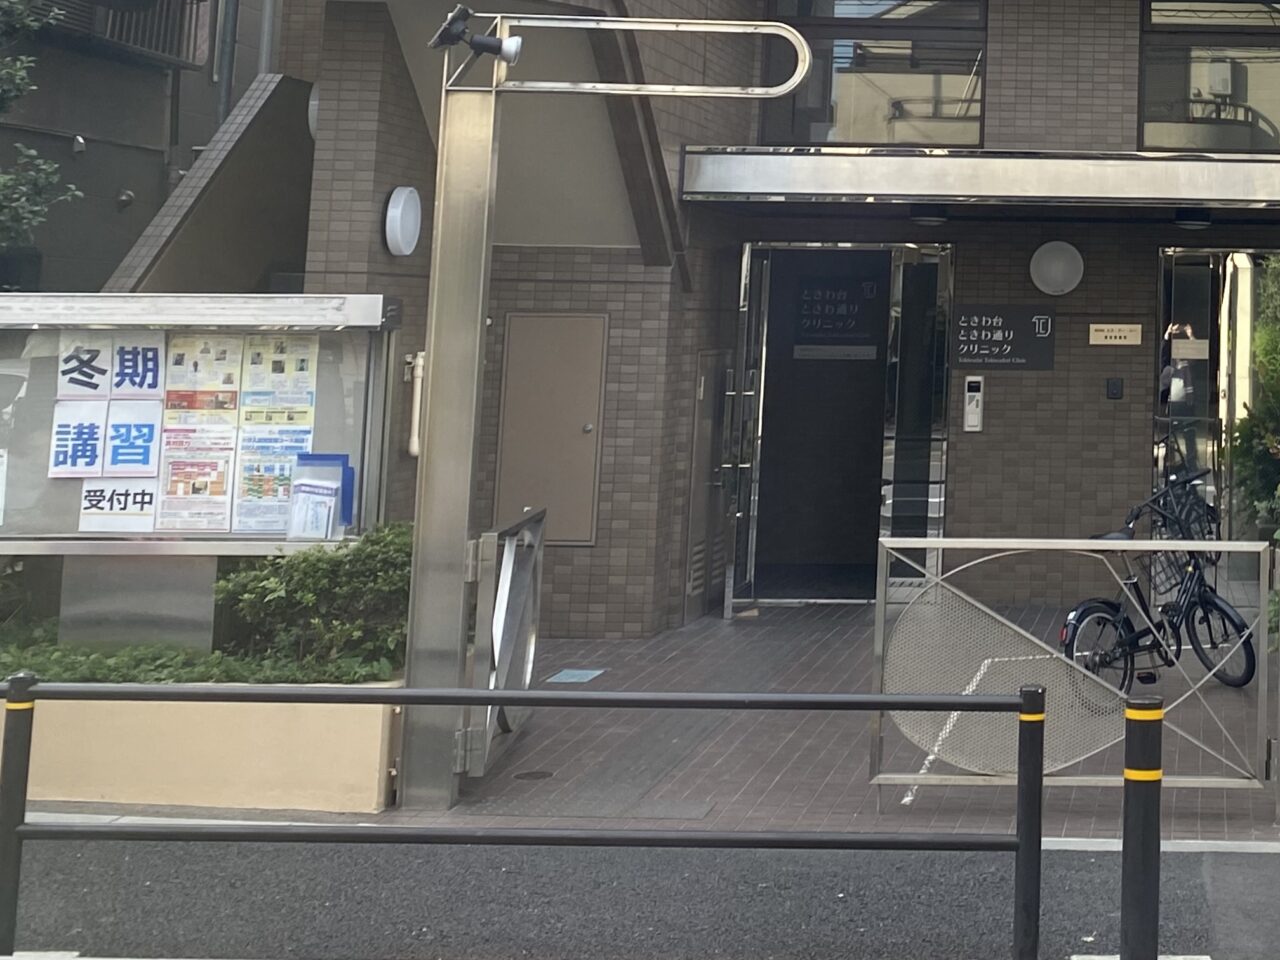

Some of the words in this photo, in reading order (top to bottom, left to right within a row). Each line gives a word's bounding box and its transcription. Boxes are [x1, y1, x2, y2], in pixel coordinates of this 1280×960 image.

[959, 315, 1003, 327] ときわ台
[958, 329, 1014, 341] ときわ通り
[958, 343, 1012, 355] クリニック
[60, 346, 160, 390] 冬期
[53, 423, 155, 467] 講習
[83, 489, 154, 512] 受付中
